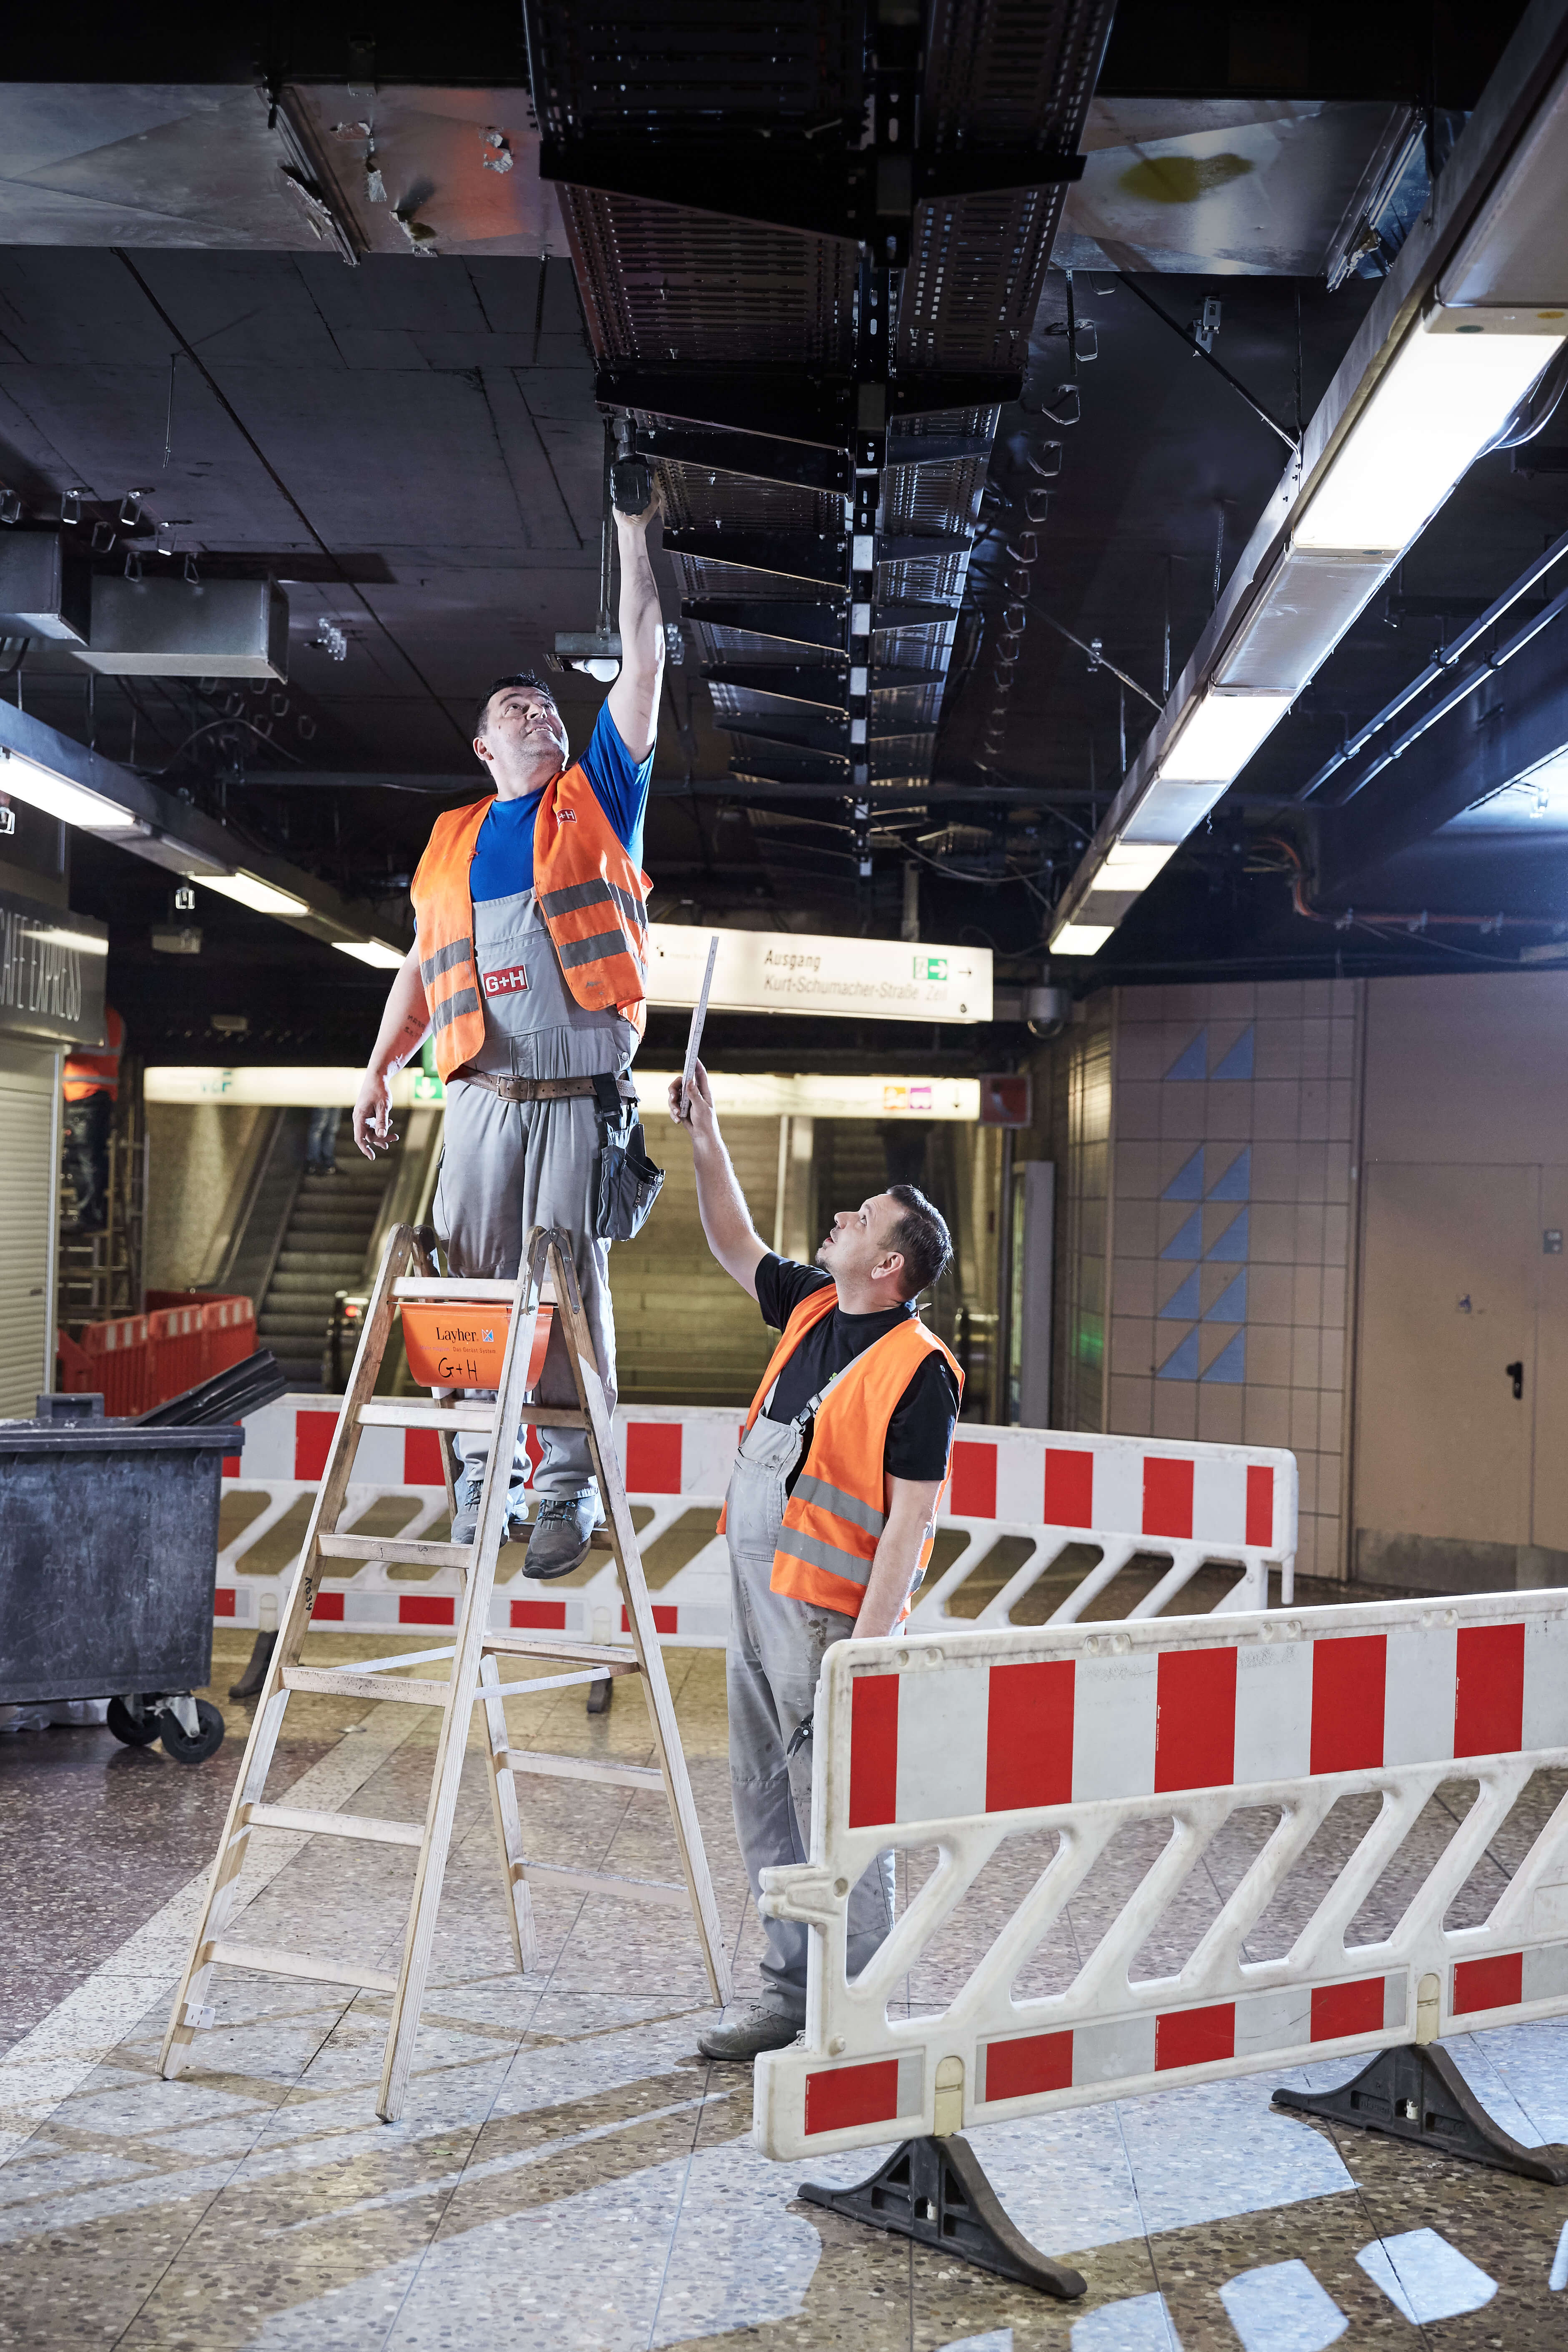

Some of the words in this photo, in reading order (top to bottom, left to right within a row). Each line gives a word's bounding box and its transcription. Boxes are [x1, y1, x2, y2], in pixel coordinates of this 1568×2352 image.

[764, 949, 821, 972] Ausgang
[485, 970, 525, 993] G+H
[764, 975, 919, 1000] Kurt-Schumacher-Straße
[436, 1327, 477, 1344] Layher
